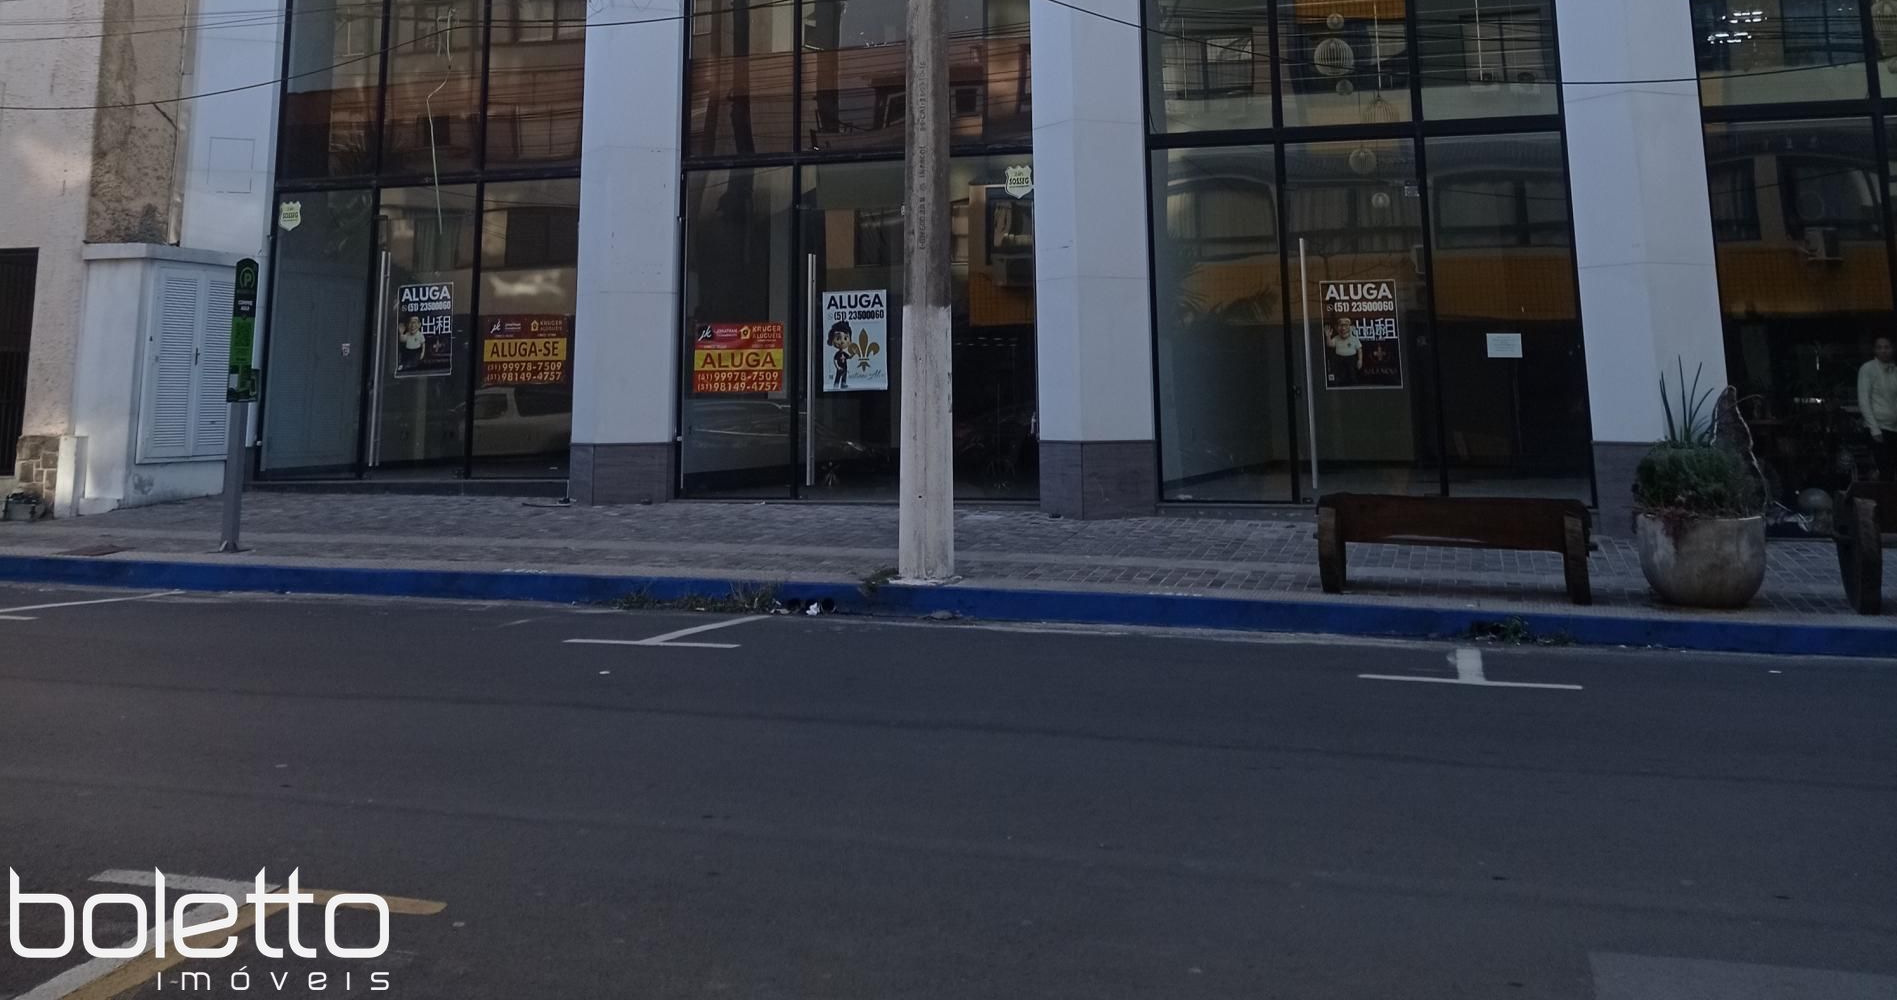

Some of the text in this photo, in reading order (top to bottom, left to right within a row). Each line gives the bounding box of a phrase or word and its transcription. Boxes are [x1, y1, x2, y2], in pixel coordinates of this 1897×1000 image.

[401, 286, 451, 302] ALUGA
[1325, 283, 1392, 300] ALUGA
[827, 293, 883, 310] ALUGA
[1334, 300, 1394, 312] (51) 23500060
[834, 310, 885, 320] (51) 23500060
[421, 315, 452, 335] 出租
[490, 341, 560, 358] ALUGA-SE
[502, 362, 562, 371] 99978-7509
[701, 352, 777, 369] ALUGA
[501, 371, 562, 381] 98149-4757
[714, 372, 779, 381] 99978-7509
[713, 382, 778, 392] 98149-4757
